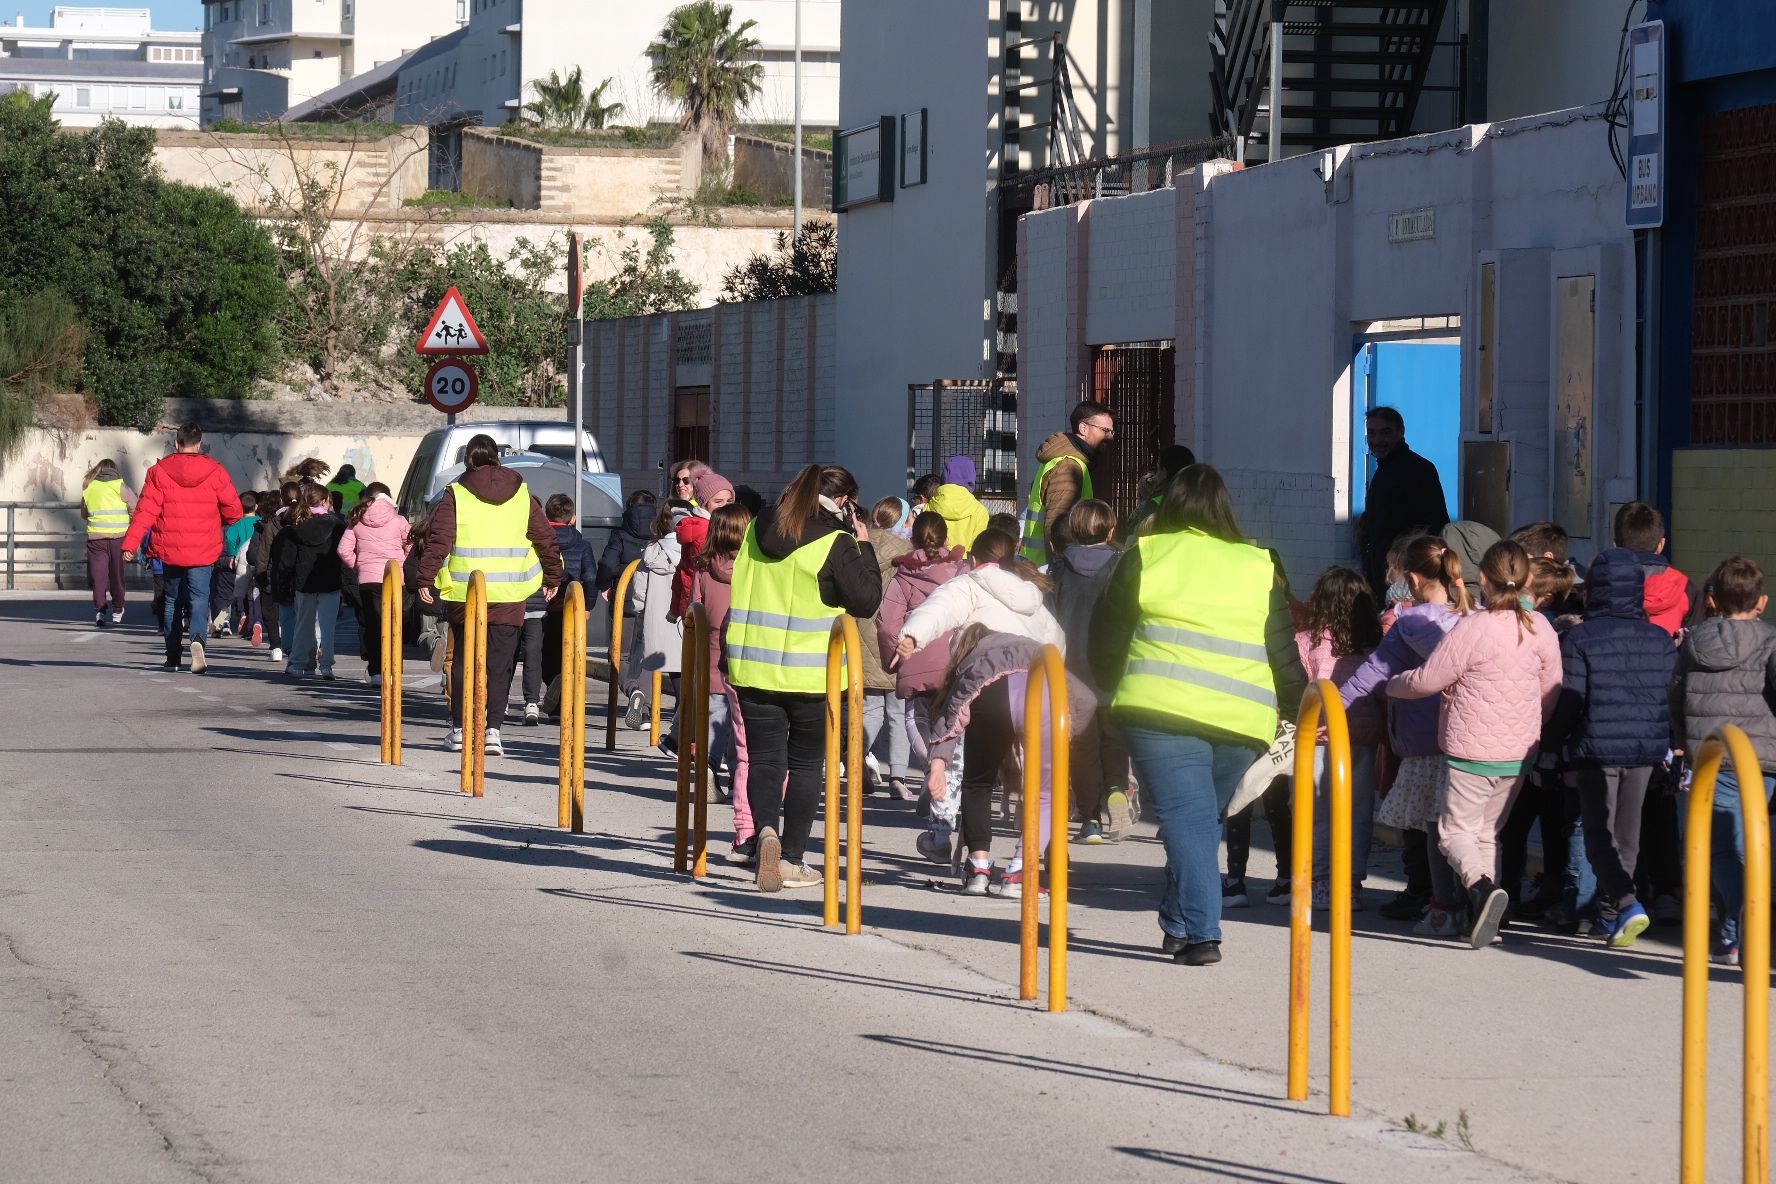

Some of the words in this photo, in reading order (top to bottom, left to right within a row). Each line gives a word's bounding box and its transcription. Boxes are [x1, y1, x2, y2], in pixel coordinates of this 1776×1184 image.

[1638, 157, 1651, 179] BUS
[1632, 183, 1657, 205] URBANO
[436, 376, 466, 395] 20
